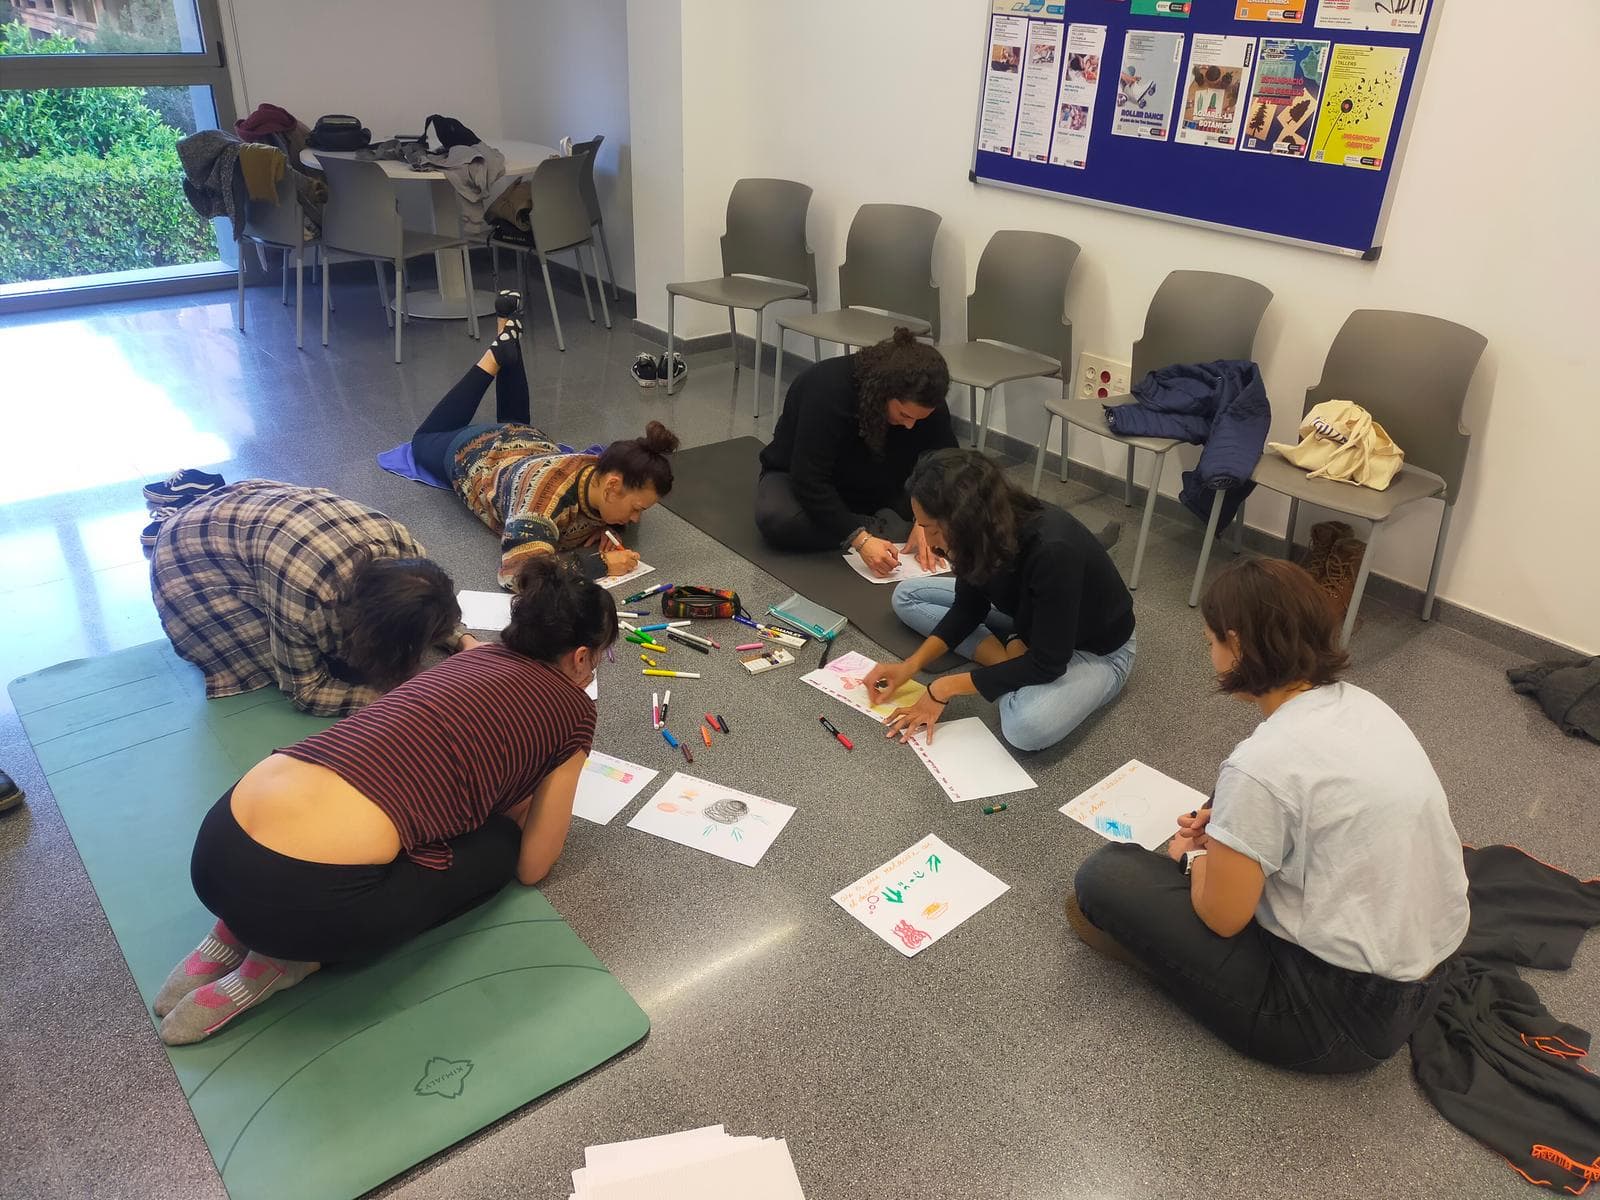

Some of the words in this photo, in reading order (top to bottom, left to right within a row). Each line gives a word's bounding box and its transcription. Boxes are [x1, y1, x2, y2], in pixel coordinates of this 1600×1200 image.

[1121, 109, 1144, 118] ROLLER
[1144, 111, 1164, 120] DANCE
[425, 1066, 463, 1089] KIMJALY
